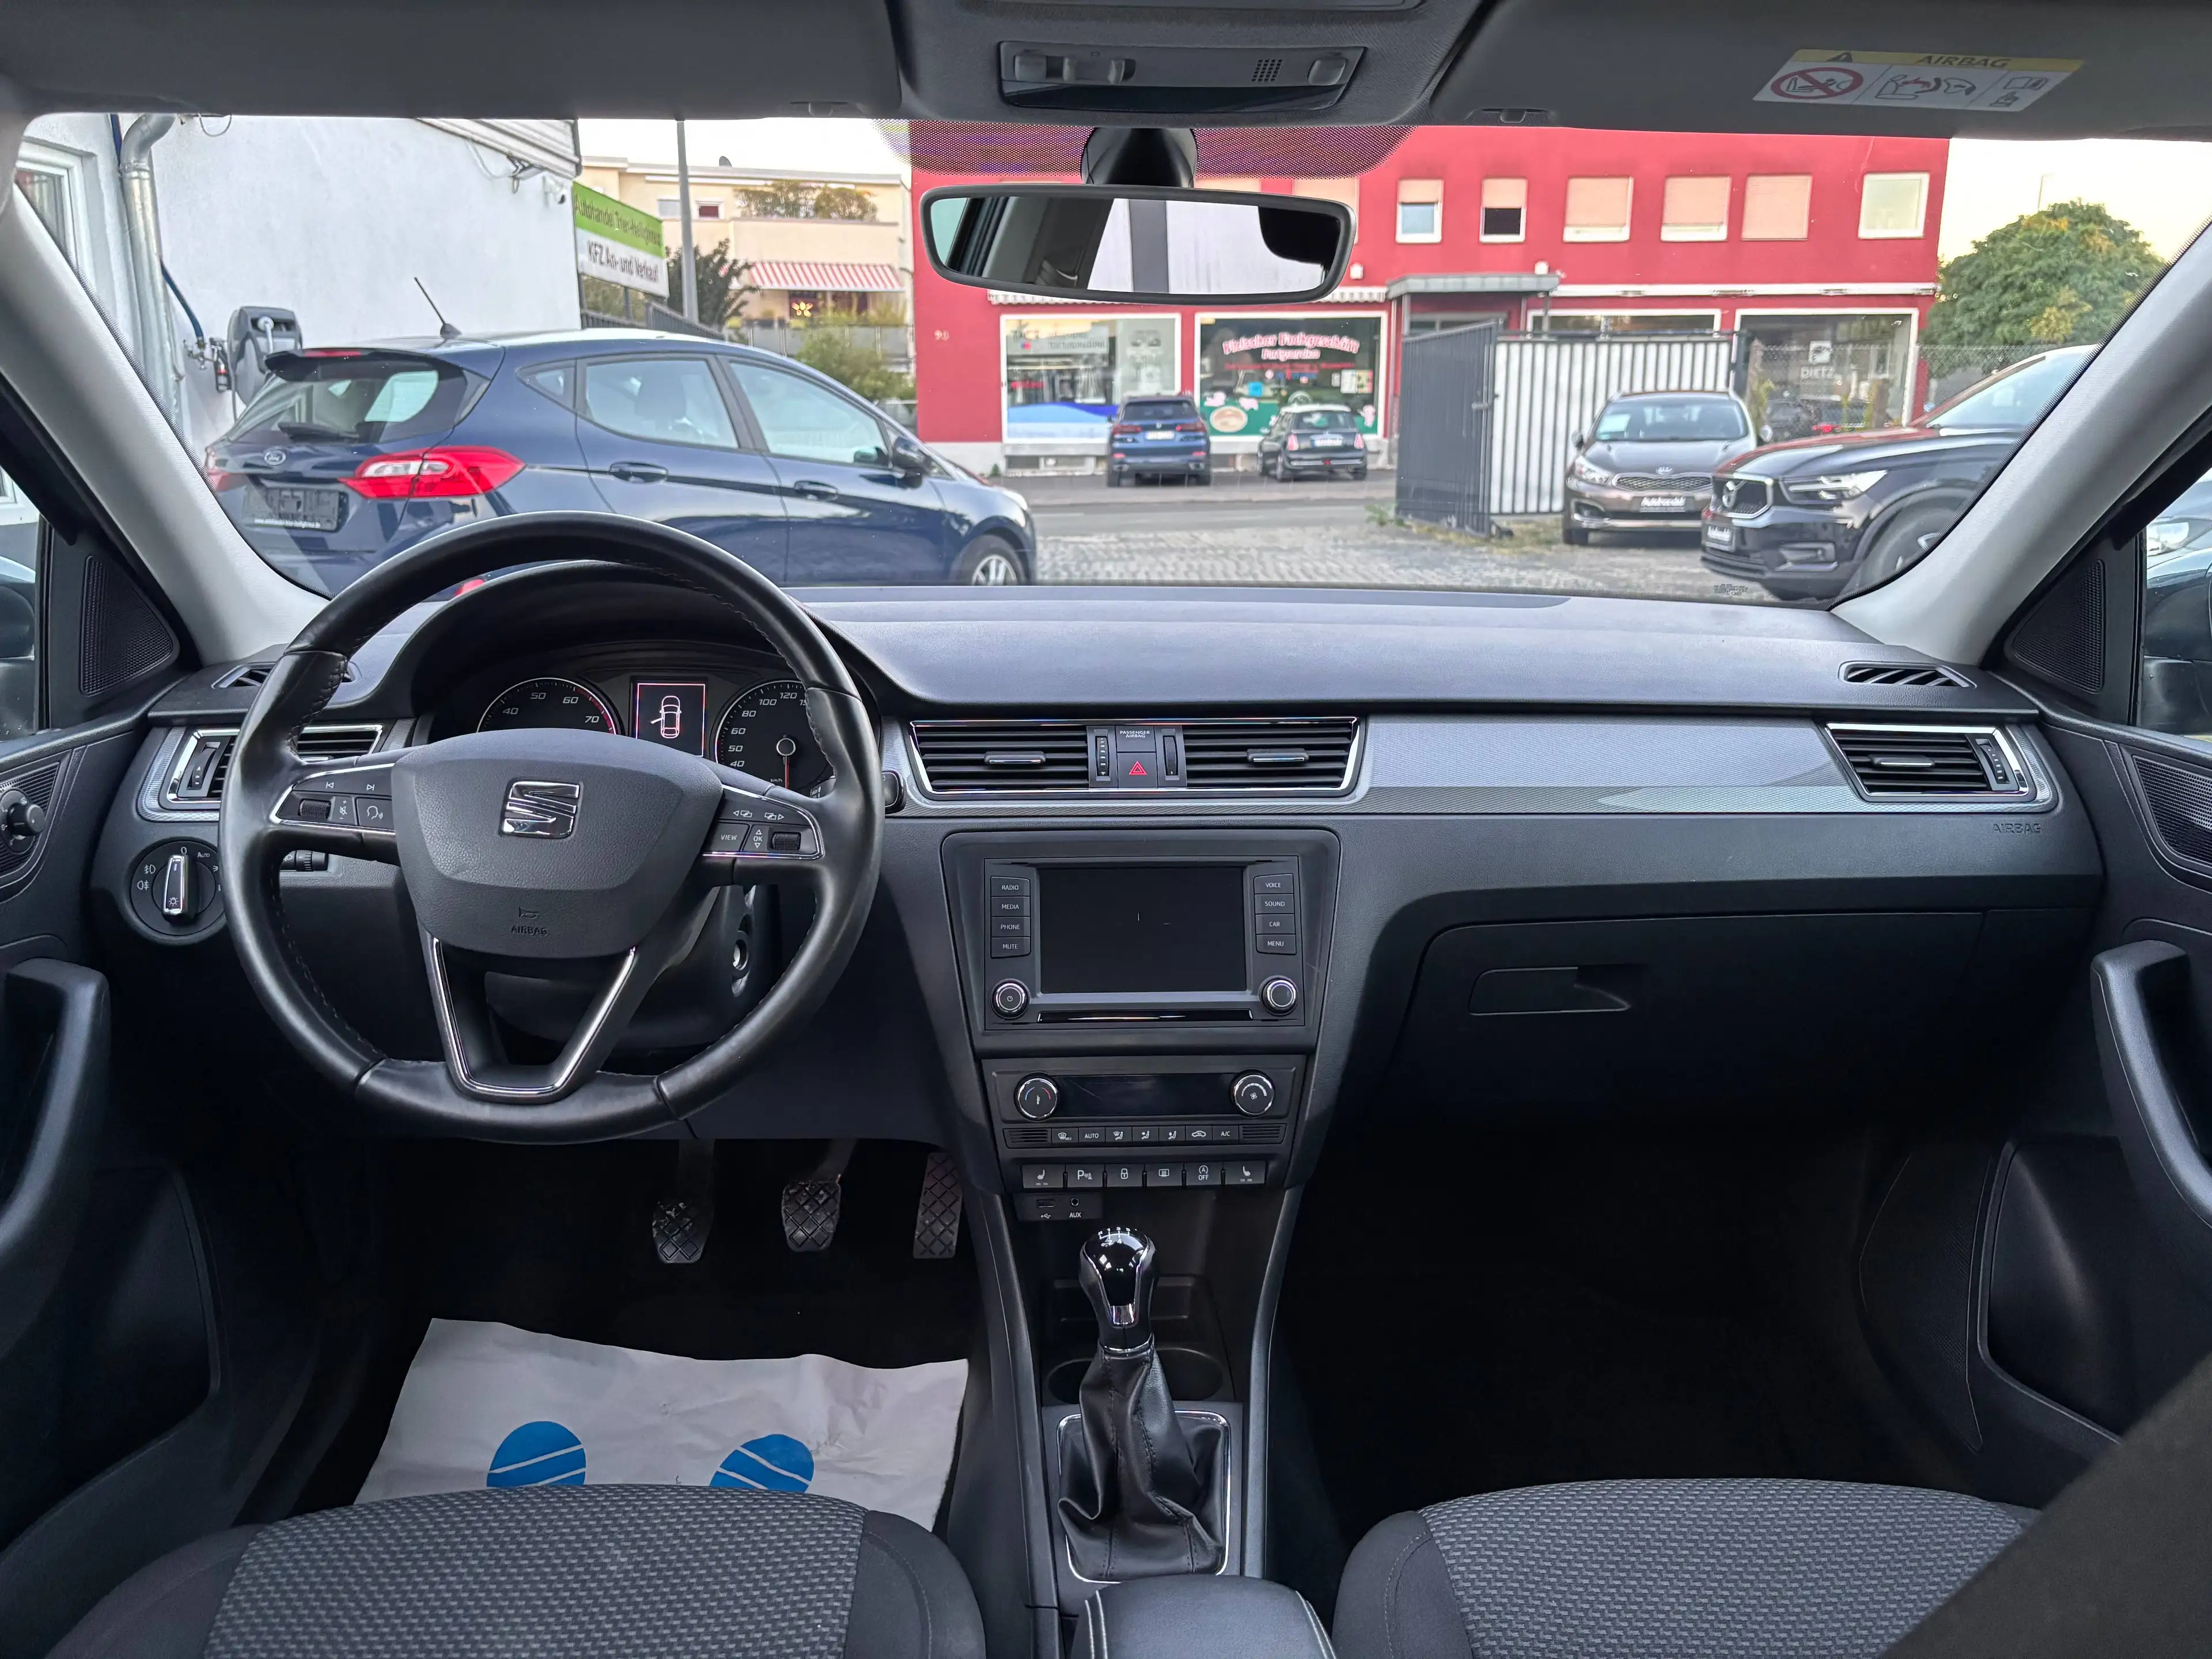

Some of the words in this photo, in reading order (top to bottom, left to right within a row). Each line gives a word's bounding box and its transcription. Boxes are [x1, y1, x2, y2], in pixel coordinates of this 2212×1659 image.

[1914, 55, 2012, 68] AIRBAG
[588, 240, 604, 266] KFZ
[620, 257, 634, 275] und
[1993, 823, 2040, 833] AIRBAG
[510, 925, 547, 935] AIRBAG
